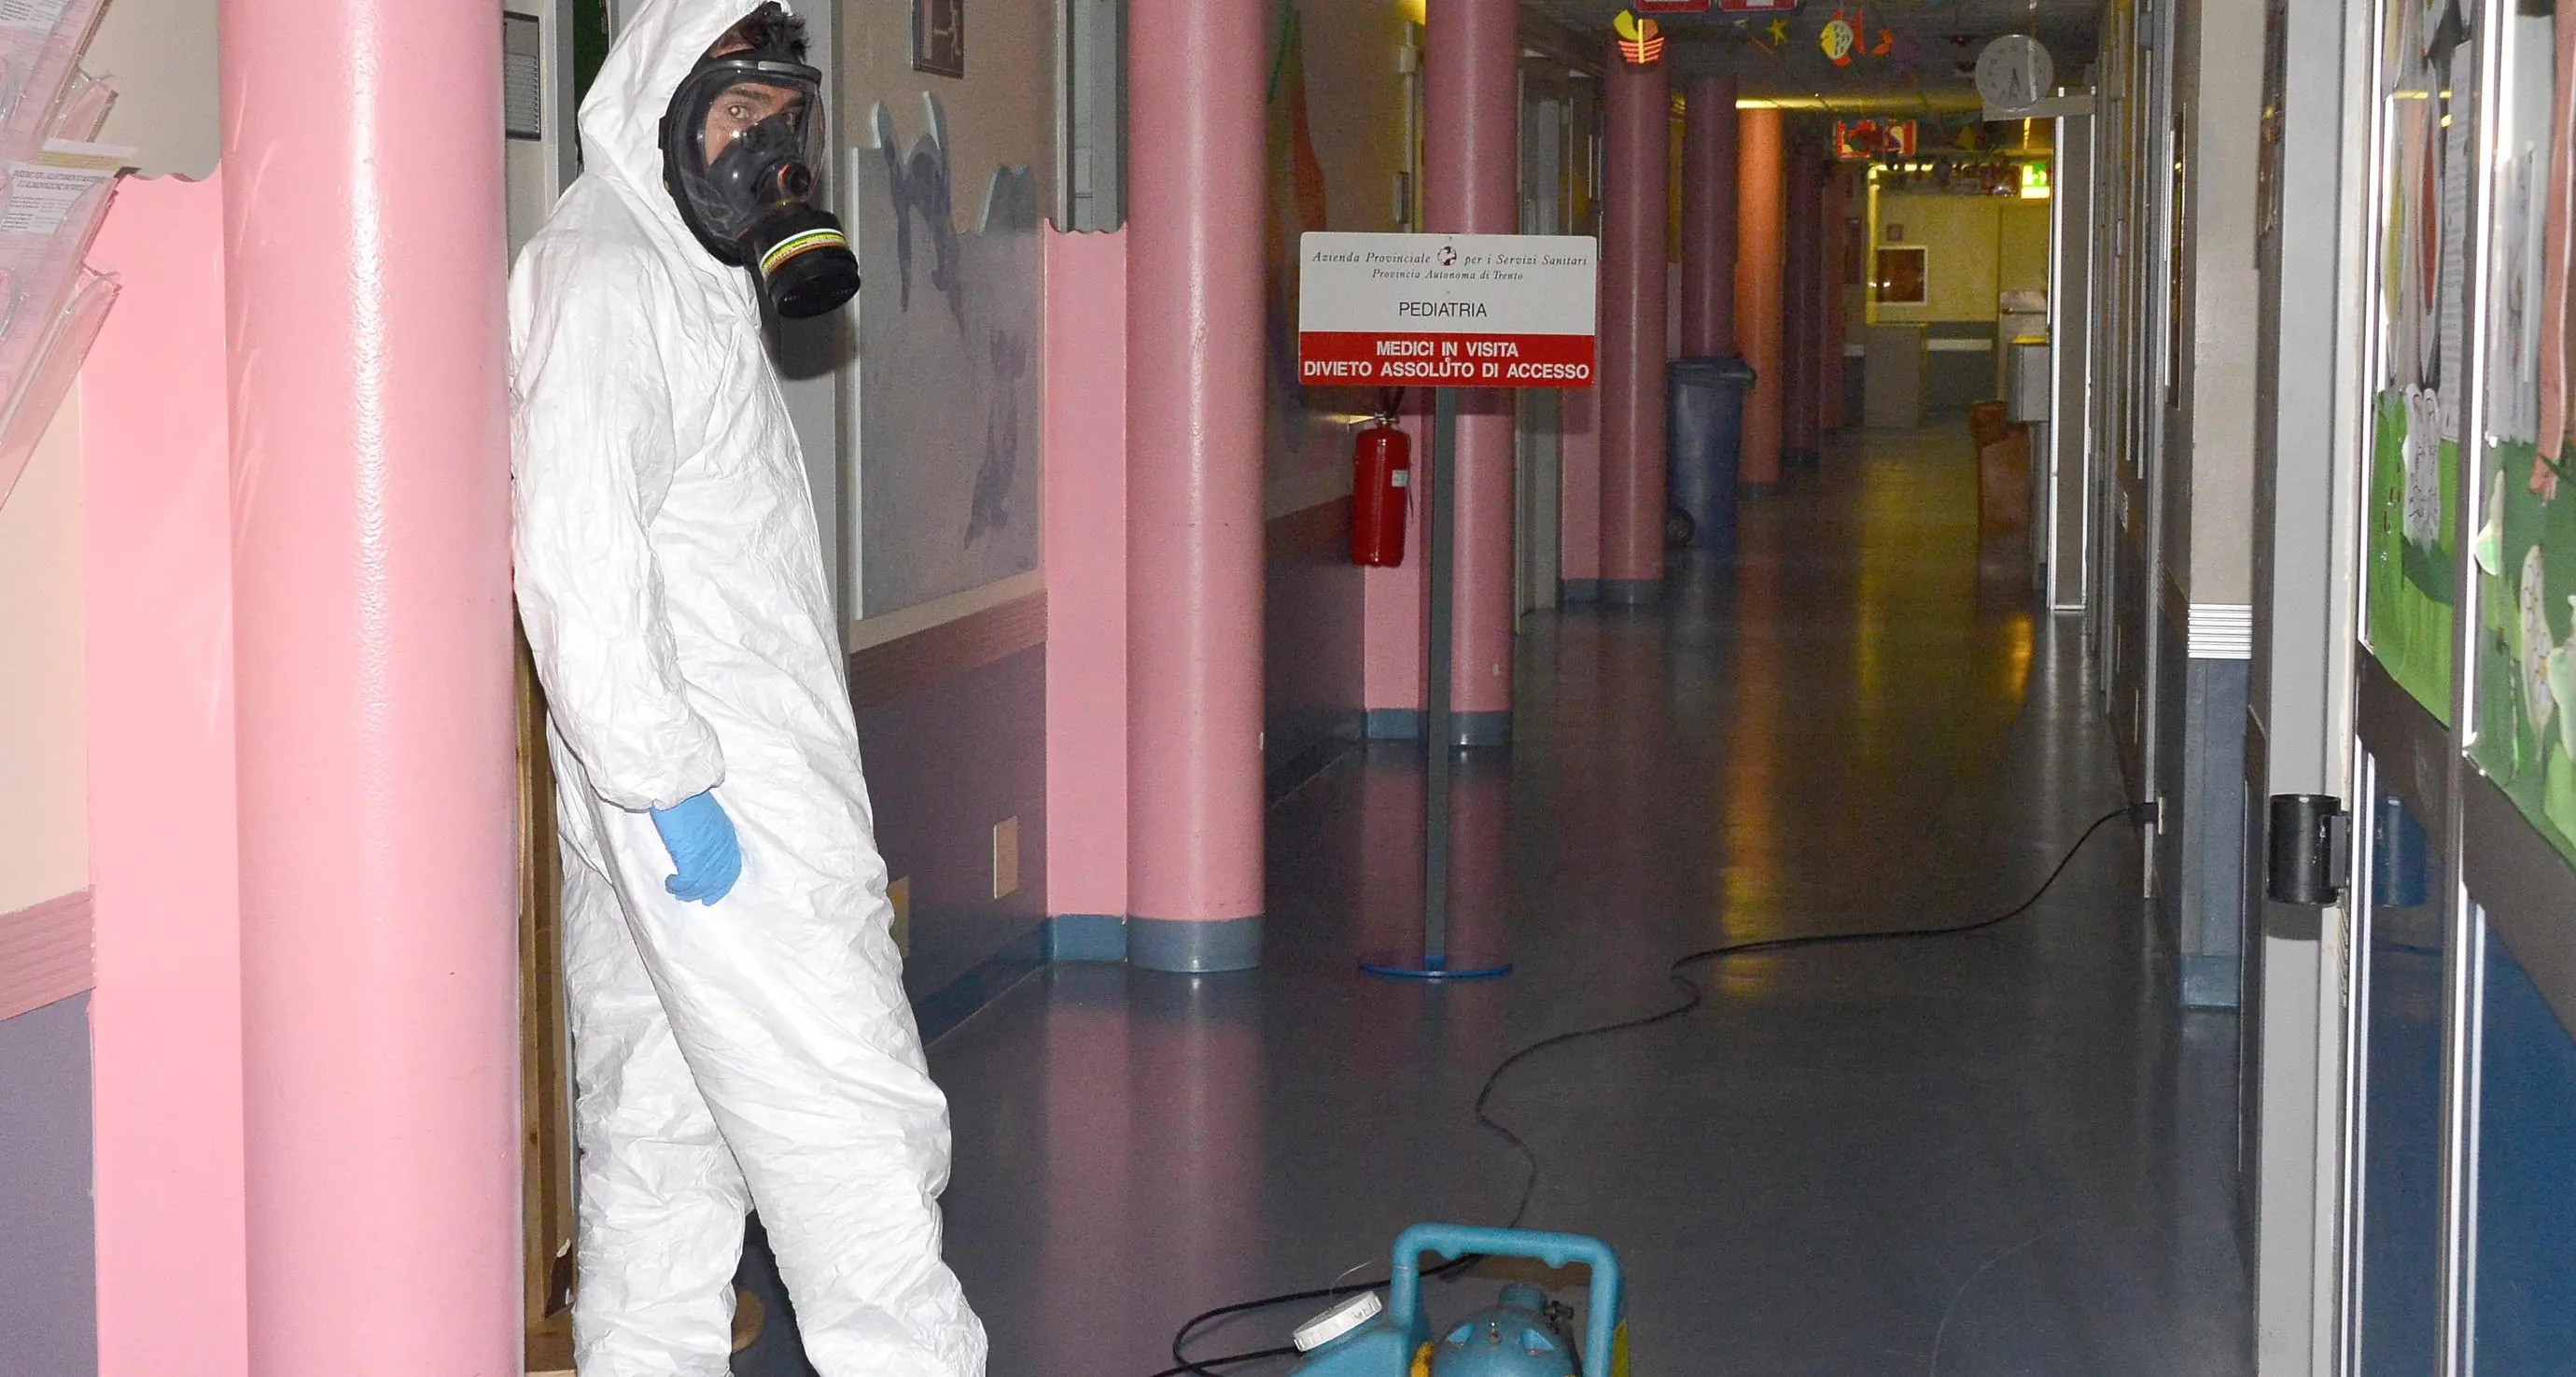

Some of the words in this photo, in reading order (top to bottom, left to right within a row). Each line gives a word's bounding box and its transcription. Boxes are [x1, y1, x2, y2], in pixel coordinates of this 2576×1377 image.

[1311, 251, 1360, 262] Azienda
[1365, 252, 1431, 264] Provinciale
[1464, 256, 1482, 267] per
[1496, 254, 1537, 265] Servizi
[1542, 255, 1587, 266] Sanitari
[1372, 268, 1421, 279] Provincia
[1425, 269, 1476, 280] Autonoma
[1479, 270, 1490, 280] di
[1493, 270, 1523, 280] Trento
[1399, 302, 1488, 318] PEDIATRIA
[1377, 341, 1434, 356] MEDICI
[1441, 342, 1458, 357] IN
[1466, 342, 1519, 358] VISITA
[1304, 361, 1372, 376] DIVIETO
[1380, 362, 1475, 378] ASSOLUTO
[1482, 362, 1499, 377] DI
[1506, 363, 1589, 379] ACCESSO
